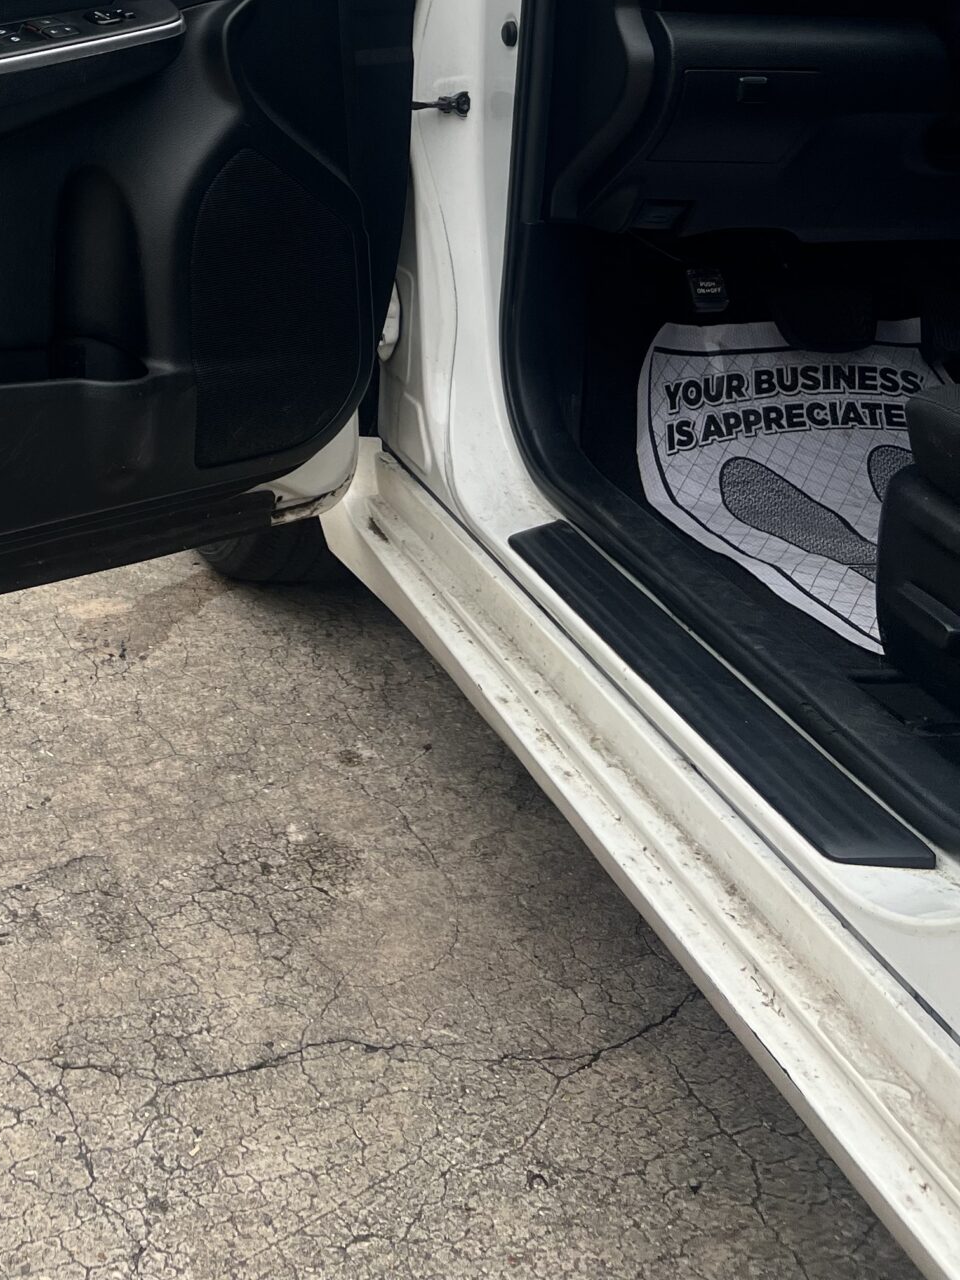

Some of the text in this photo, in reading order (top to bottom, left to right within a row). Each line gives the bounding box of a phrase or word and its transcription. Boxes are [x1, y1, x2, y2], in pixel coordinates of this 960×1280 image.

[663, 364, 923, 413] YOUR BUSINESS
[666, 400, 907, 453] IS APPRECIATE
